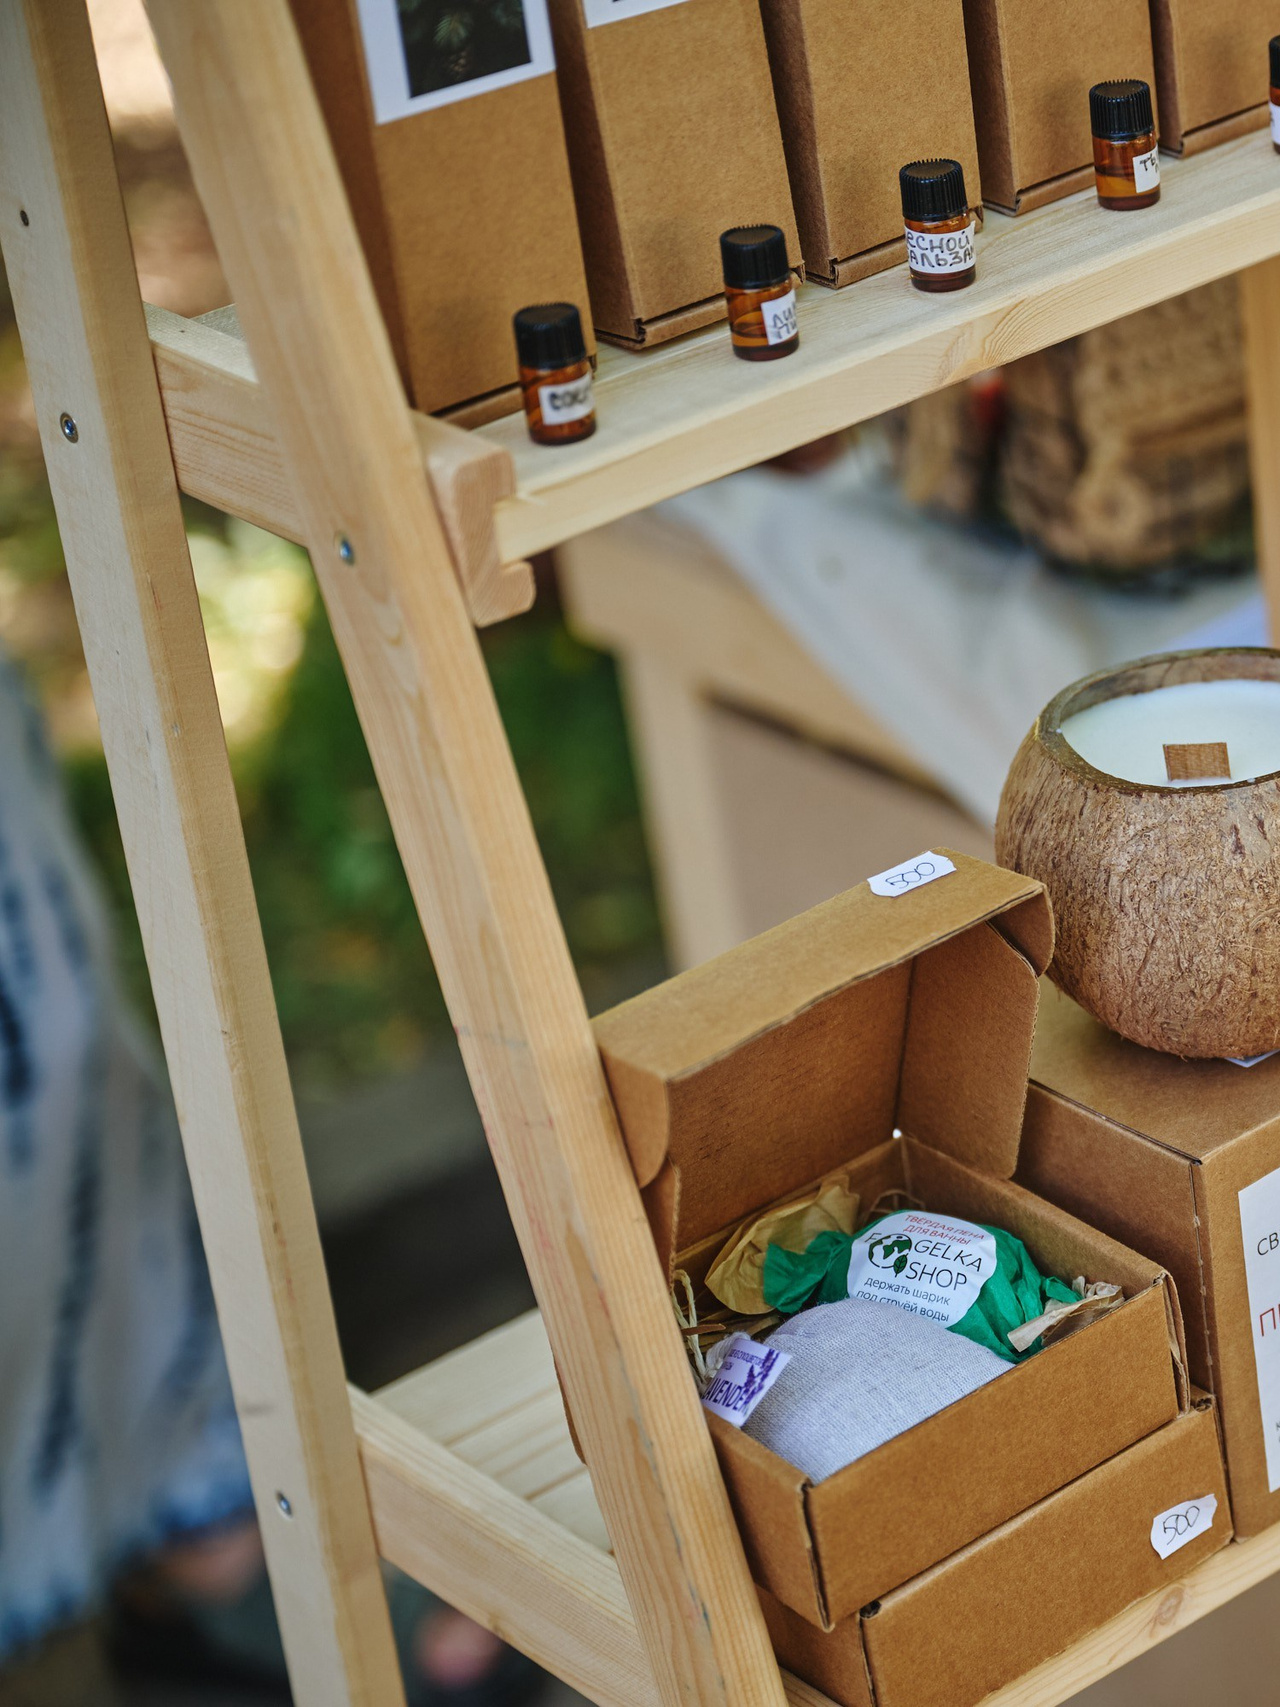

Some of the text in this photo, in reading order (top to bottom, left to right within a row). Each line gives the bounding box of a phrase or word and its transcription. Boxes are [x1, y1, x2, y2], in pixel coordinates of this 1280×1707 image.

[885, 862, 935, 889] 500
[903, 1224, 971, 1245] ДЛЯ ВАННЫ
[904, 1214, 985, 1240] ТВЁРДАЯ ПЕНА
[905, 1261, 967, 1291] SHOP
[864, 1277, 951, 1306] держать шарик
[920, 1306, 950, 1322] воды
[1162, 1505, 1200, 1546] 500
